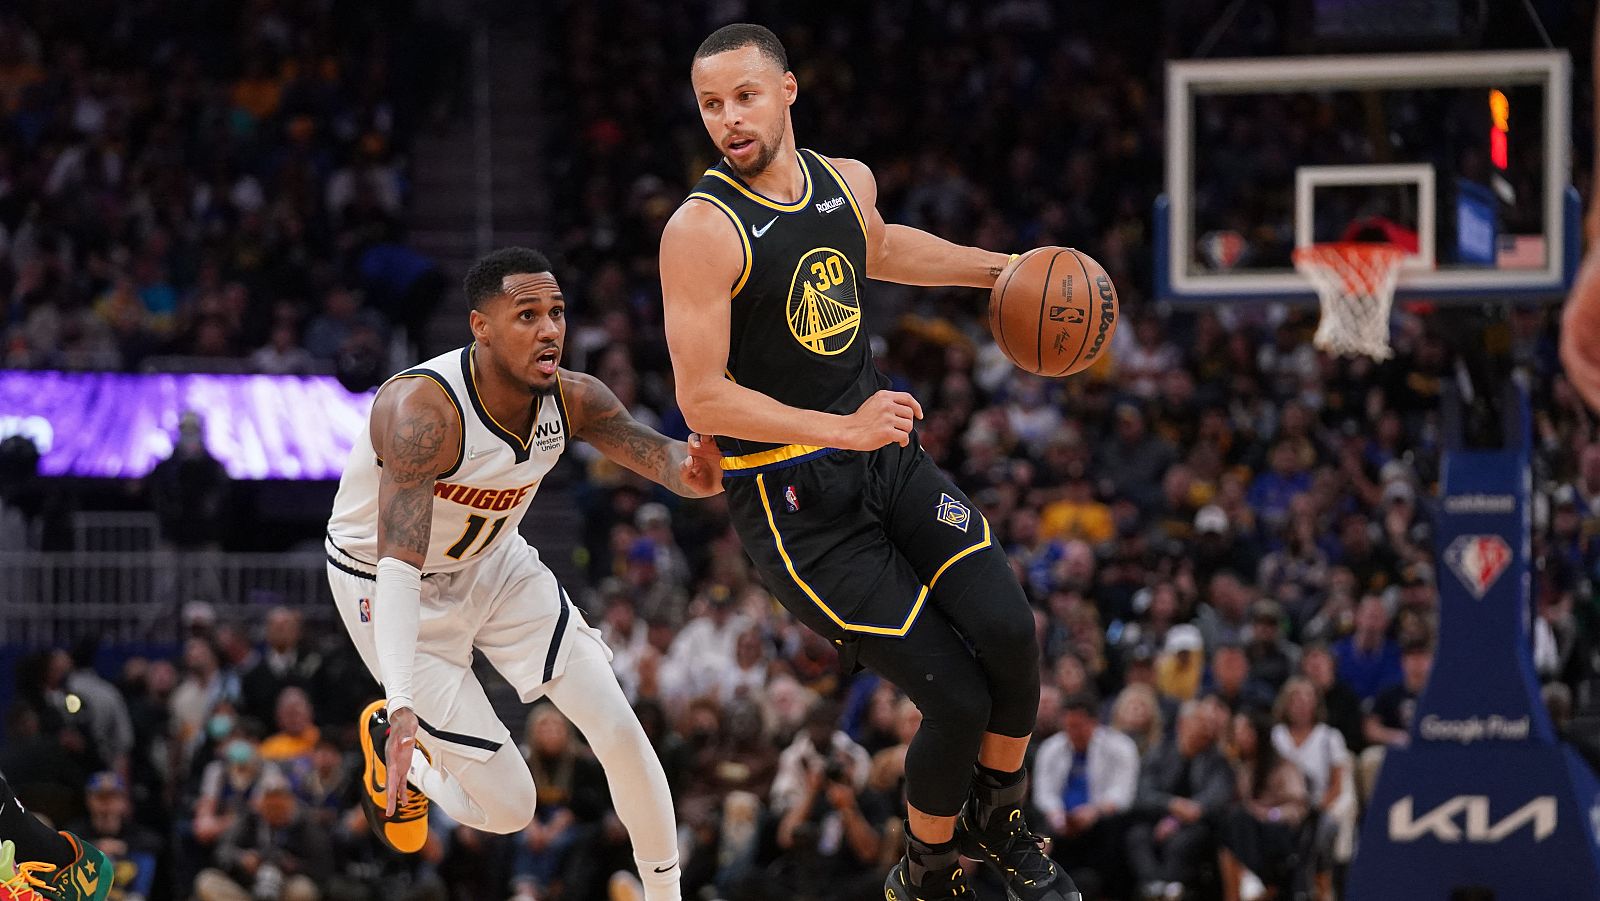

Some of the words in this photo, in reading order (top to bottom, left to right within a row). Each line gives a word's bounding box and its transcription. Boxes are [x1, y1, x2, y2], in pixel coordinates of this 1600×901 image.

[815, 196, 846, 213] Rakuten
[810, 255, 844, 292] 30
[535, 436, 564, 447] Western
[541, 443, 561, 452] Union
[445, 514, 510, 560] 11
